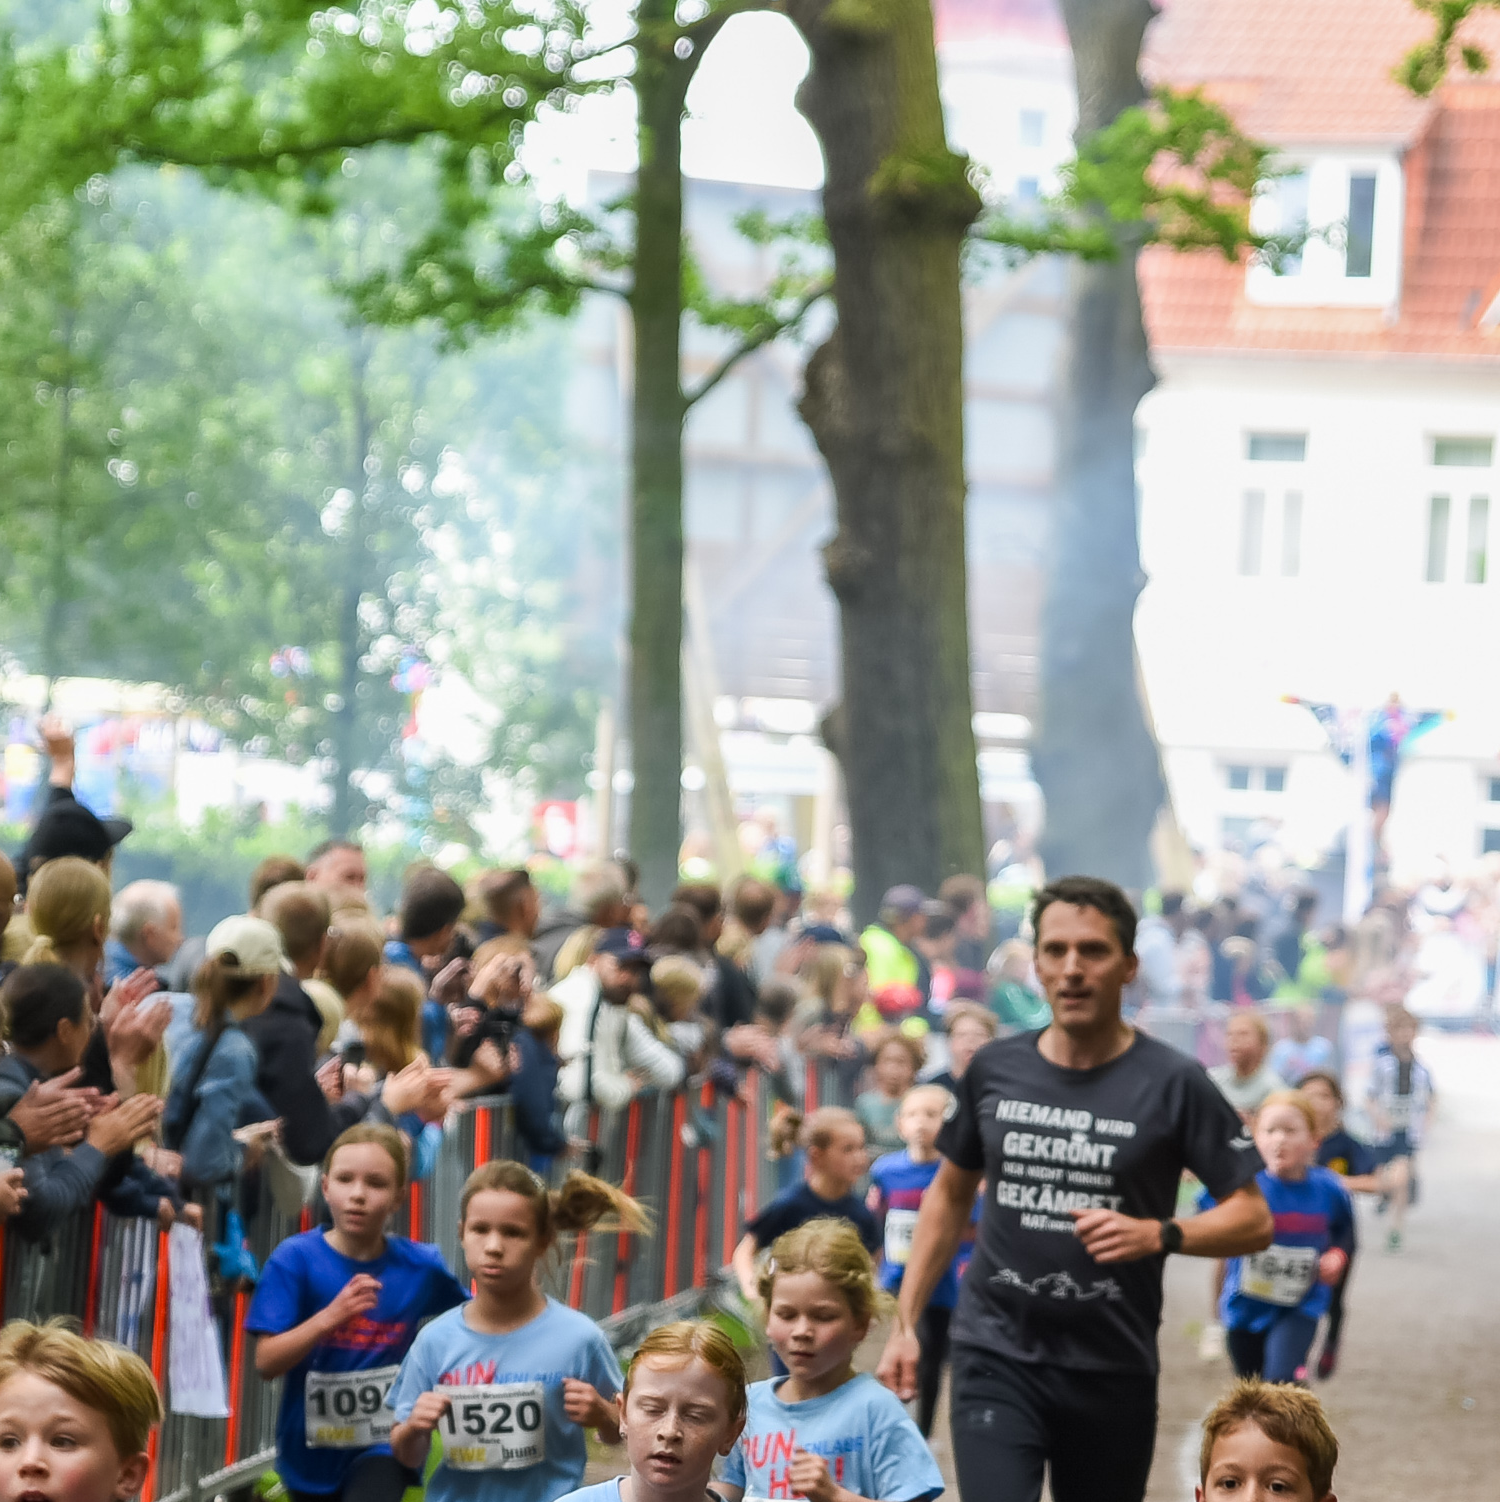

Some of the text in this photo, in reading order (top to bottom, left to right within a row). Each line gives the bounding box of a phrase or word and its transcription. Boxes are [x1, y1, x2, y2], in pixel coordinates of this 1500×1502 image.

[995, 1099, 1137, 1138] NIEMAND WIRD
[1002, 1160, 1115, 1187] DER NICHT VORHER
[1020, 1212, 1048, 1230] HAT
[309, 1383, 393, 1417] 109
[446, 1400, 541, 1435] 1520
